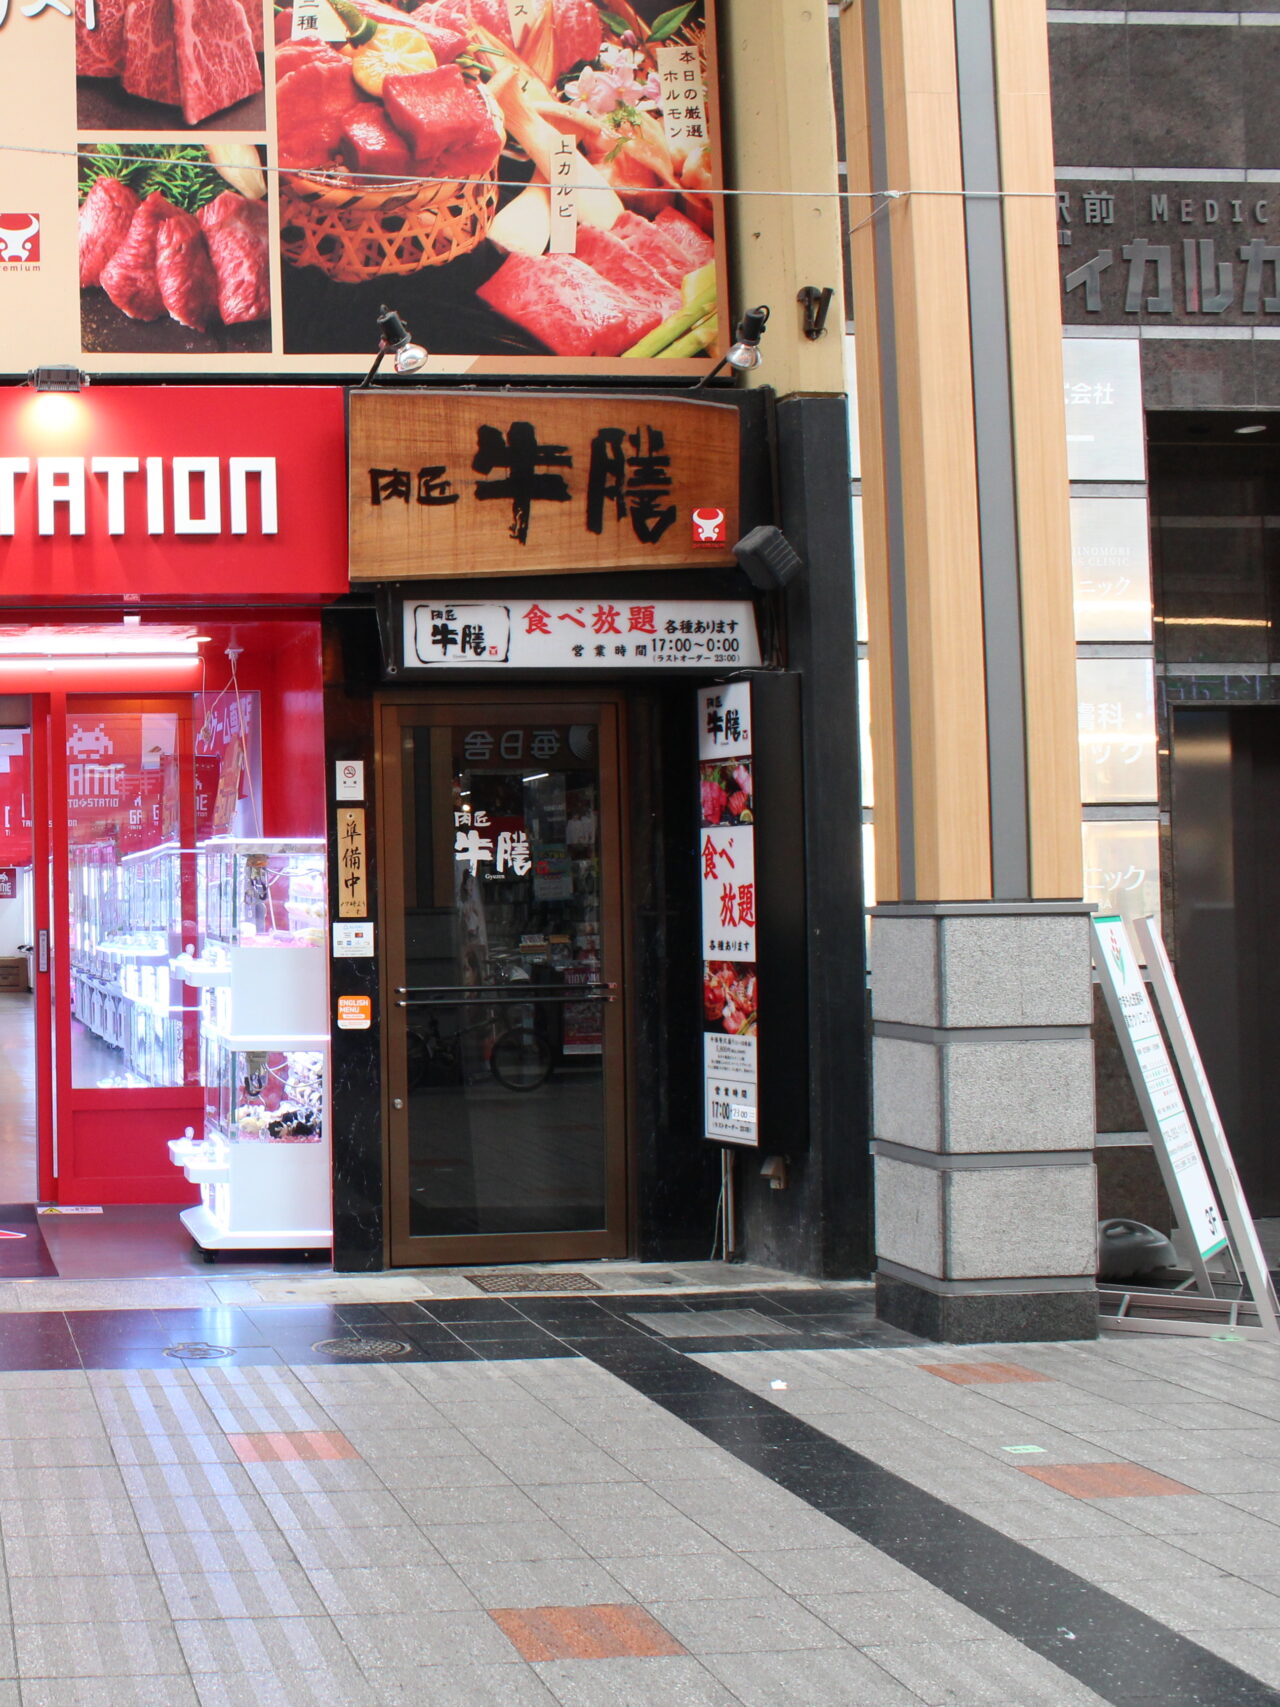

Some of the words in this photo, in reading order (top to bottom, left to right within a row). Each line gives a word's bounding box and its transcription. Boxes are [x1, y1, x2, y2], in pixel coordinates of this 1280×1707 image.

[664, 70, 683, 138] ホルモン
[679, 50, 703, 138] 本日の厳選
[555, 139, 574, 218] 上カルビ
[1151, 194, 1268, 223] MEDIC
[1058, 230, 1280, 313] ィカルカ
[370, 466, 460, 506] 肉匠
[472, 422, 677, 546] 牛膳
[431, 624, 487, 657] 牛膳
[521, 604, 657, 635] 食べ放題
[664, 619, 738, 634] 各種あります
[572, 644, 648, 657] 営業時間
[454, 811, 491, 827] 肉匠
[341, 820, 362, 898] 準備中
[454, 830, 532, 877] 牛膳
[702, 834, 735, 880] 食べ
[720, 882, 756, 928] 放題
